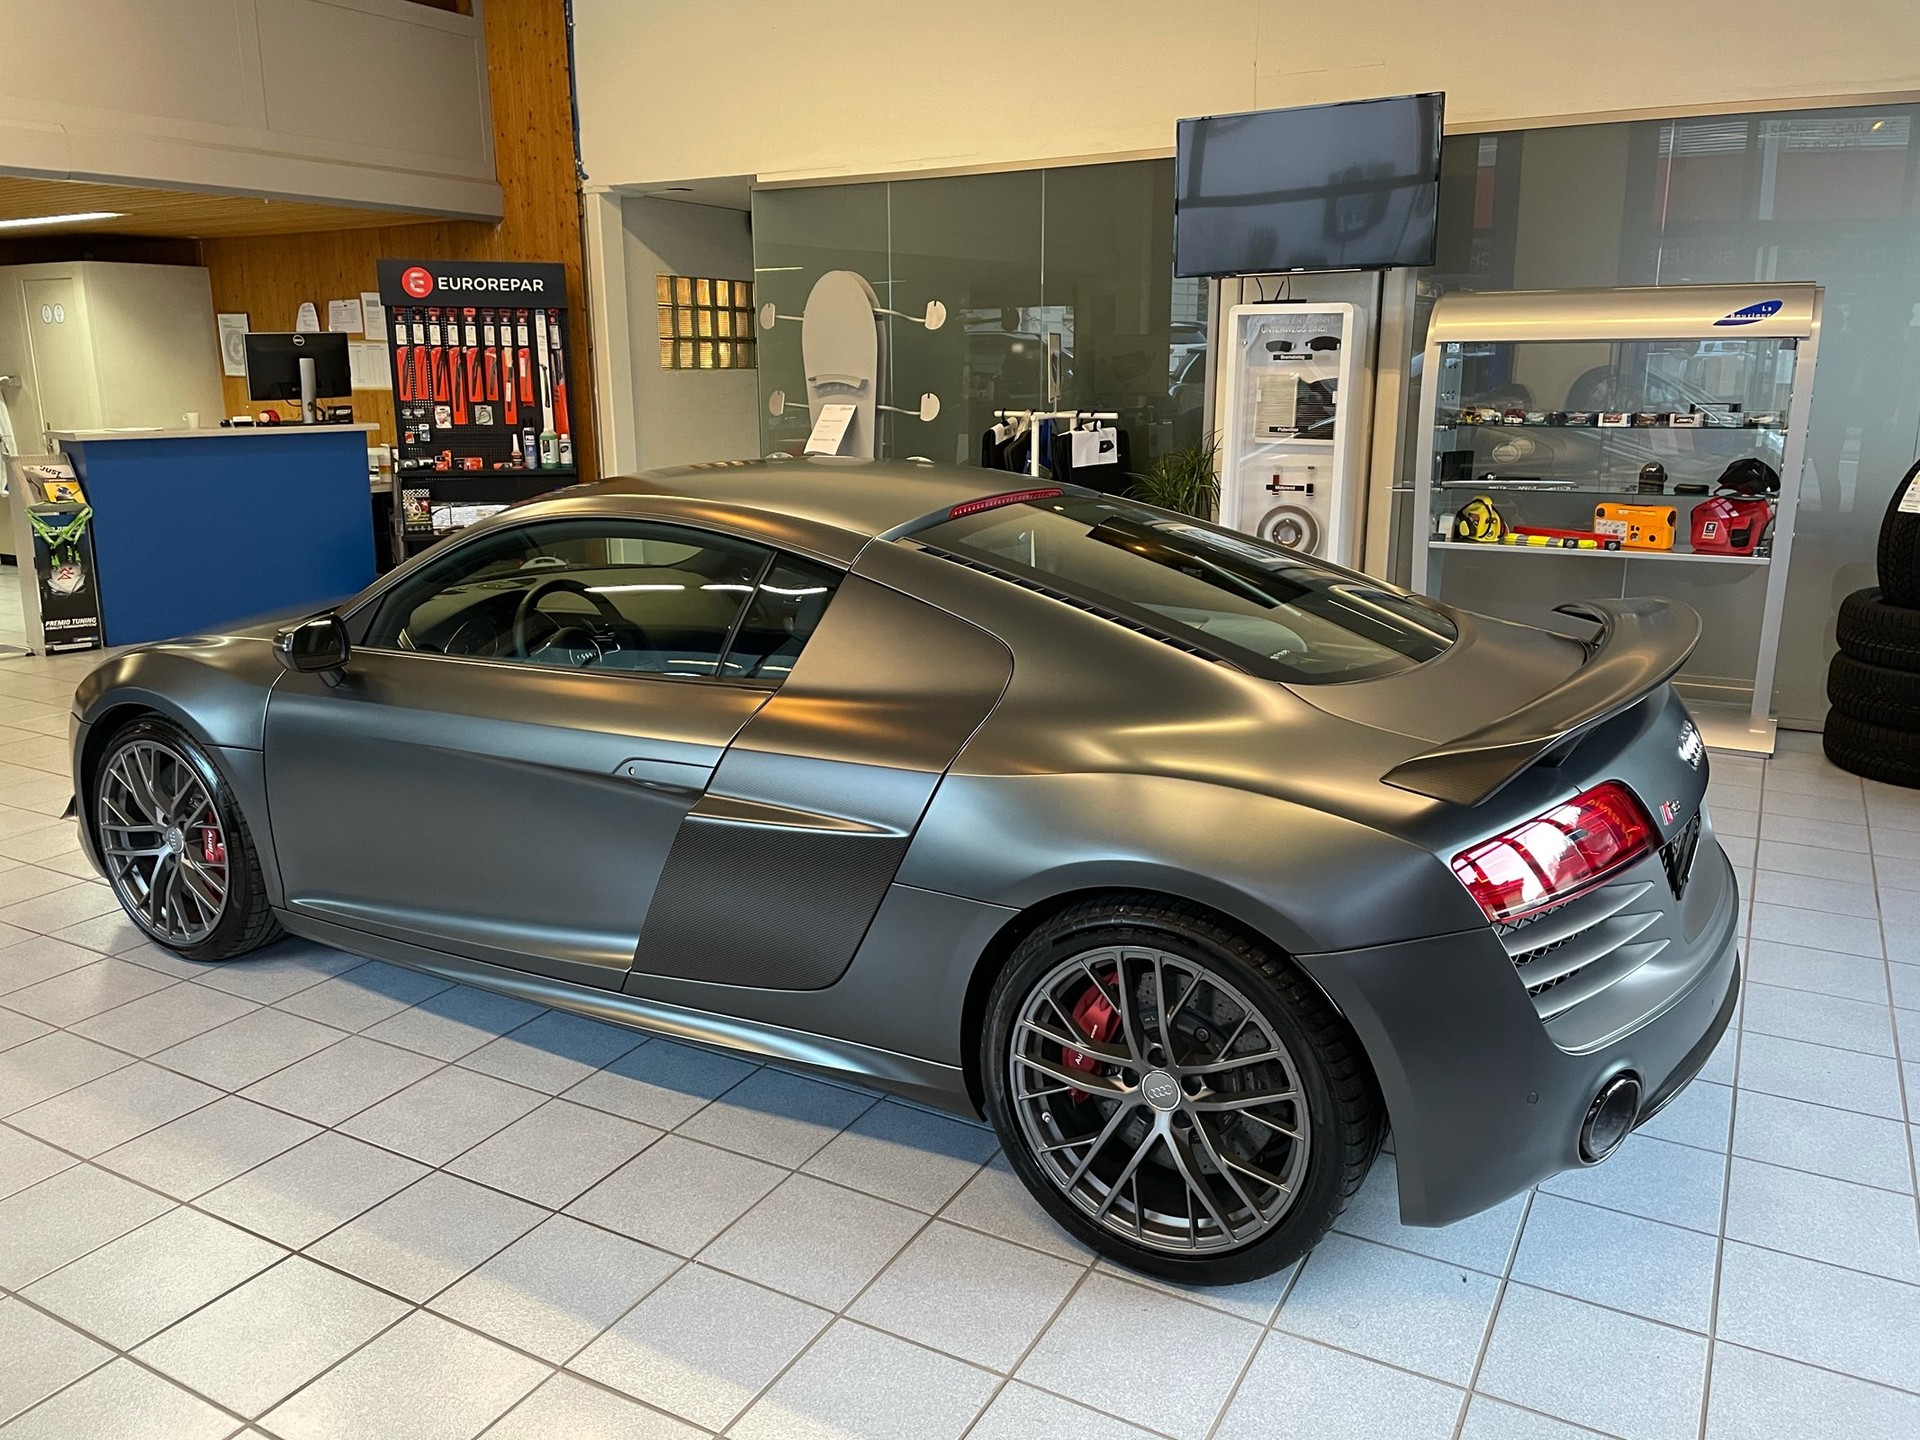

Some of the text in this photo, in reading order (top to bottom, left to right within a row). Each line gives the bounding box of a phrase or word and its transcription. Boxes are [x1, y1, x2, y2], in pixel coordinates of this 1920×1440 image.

[437, 277, 544, 292] EUROREPAR
[45, 617, 97, 627] PREMIO TUNING
